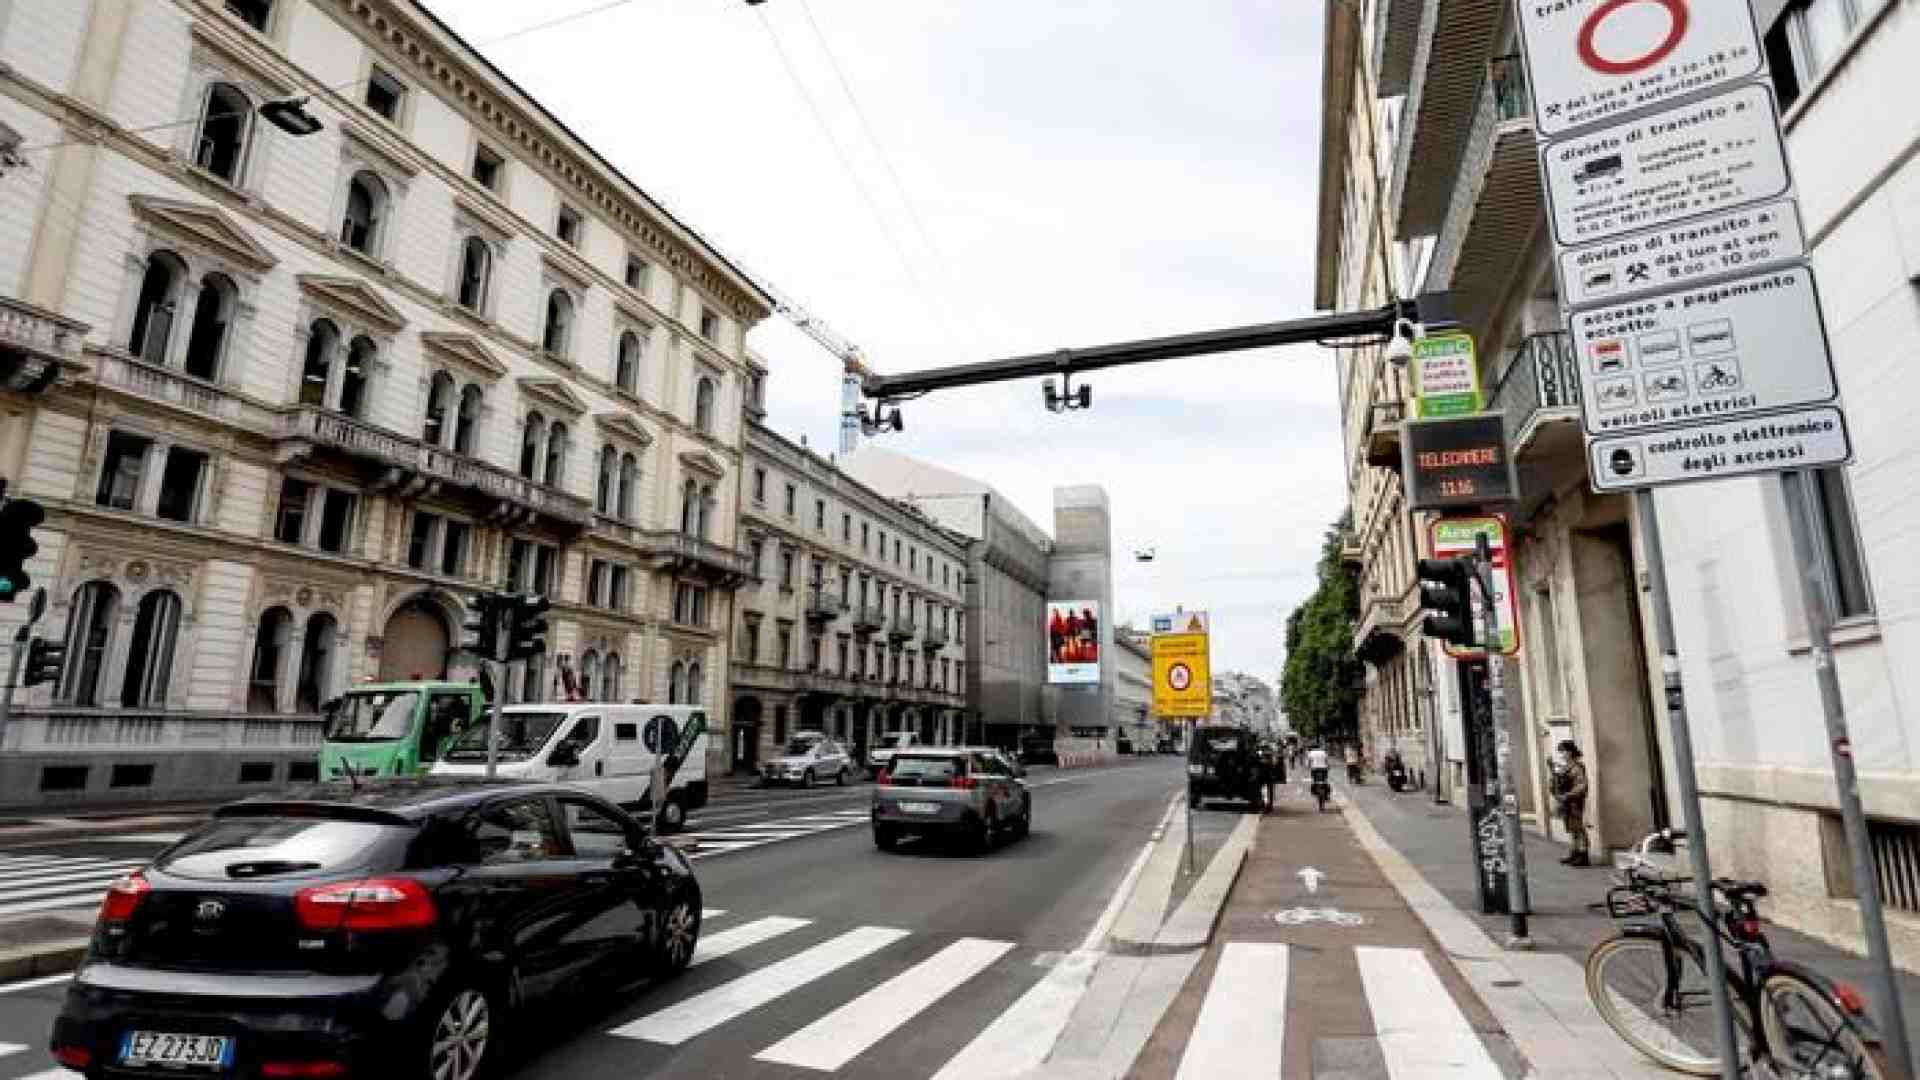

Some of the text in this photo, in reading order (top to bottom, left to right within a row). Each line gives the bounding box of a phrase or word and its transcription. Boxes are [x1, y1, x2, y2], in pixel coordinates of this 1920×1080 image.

[1560, 137, 1621, 163] divieto
[1626, 128, 1643, 144] di
[1650, 106, 1727, 136] transito
[1577, 243, 1639, 266] divieto
[1645, 234, 1664, 251] di
[1670, 216, 1751, 244] transito
[1655, 250, 1683, 267] dal
[1722, 237, 1740, 251] al
[1746, 229, 1780, 246] ven
[1584, 273, 1796, 326] accesso a pagamento
[1600, 394, 1758, 428] veicoli elettrici
[1648, 418, 1835, 454] controllo elettronico
[1683, 443, 1806, 473] degli accessi
